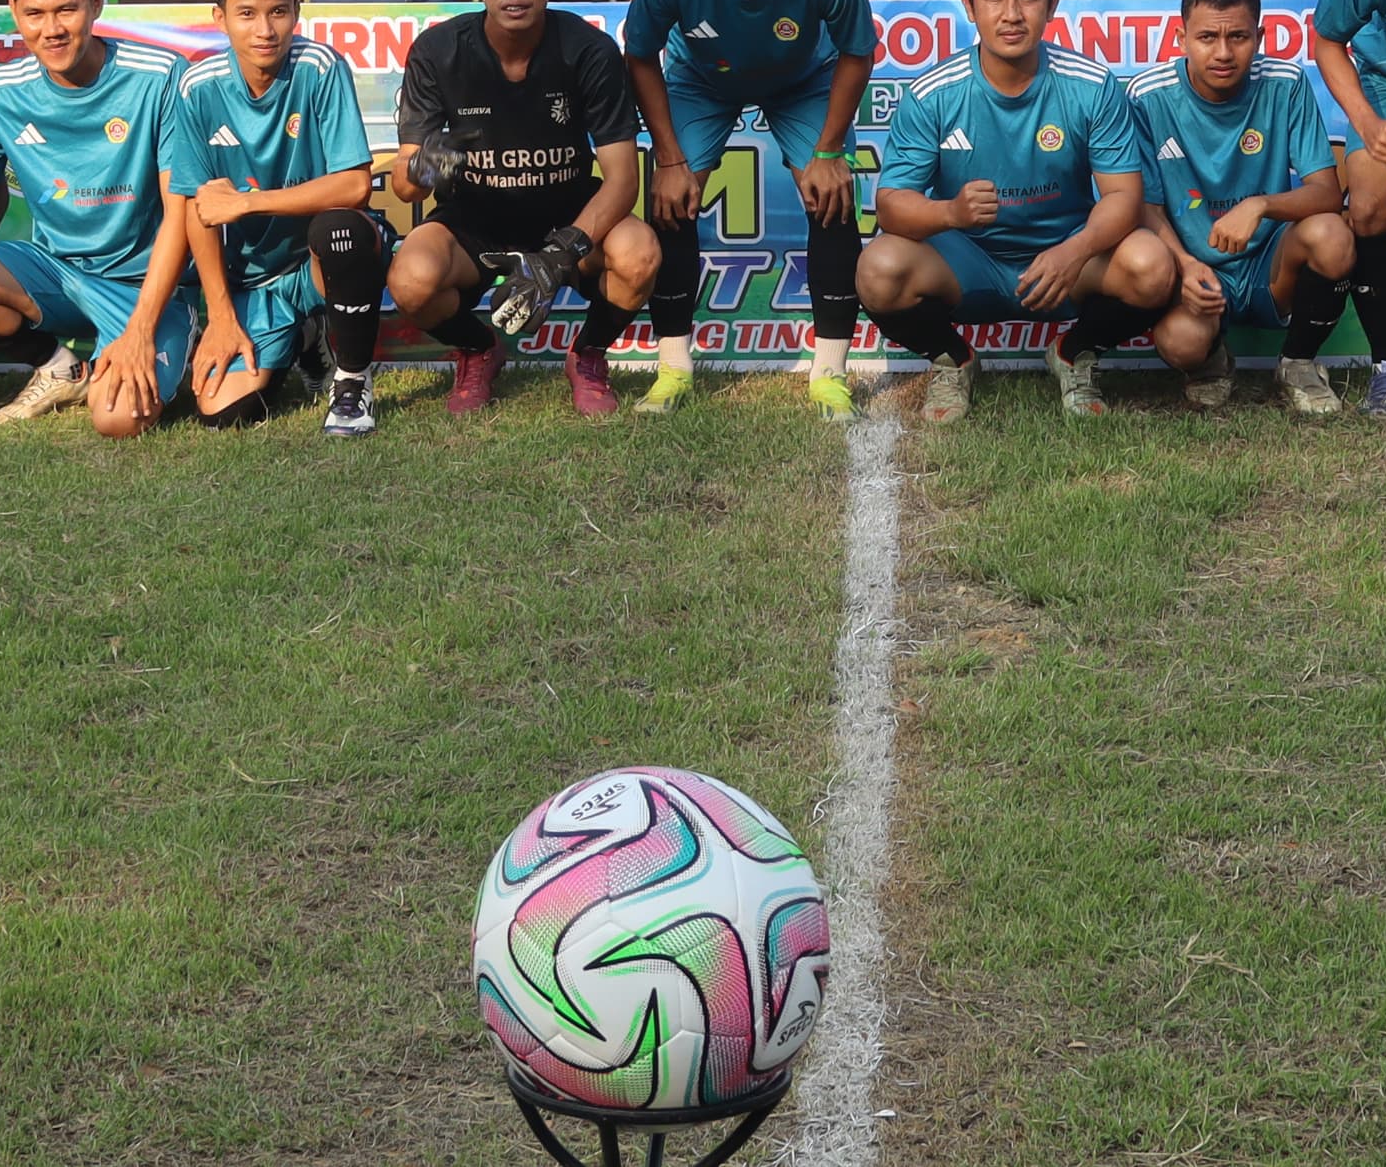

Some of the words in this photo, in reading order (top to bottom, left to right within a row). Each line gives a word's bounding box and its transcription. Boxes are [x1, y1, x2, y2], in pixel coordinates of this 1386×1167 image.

[501, 146, 577, 168] GROUP
[464, 170, 482, 185] CV
[486, 172, 544, 188] Mandiri
[74, 183, 135, 198] PERTAMINA
[570, 781, 628, 822] SPECS
